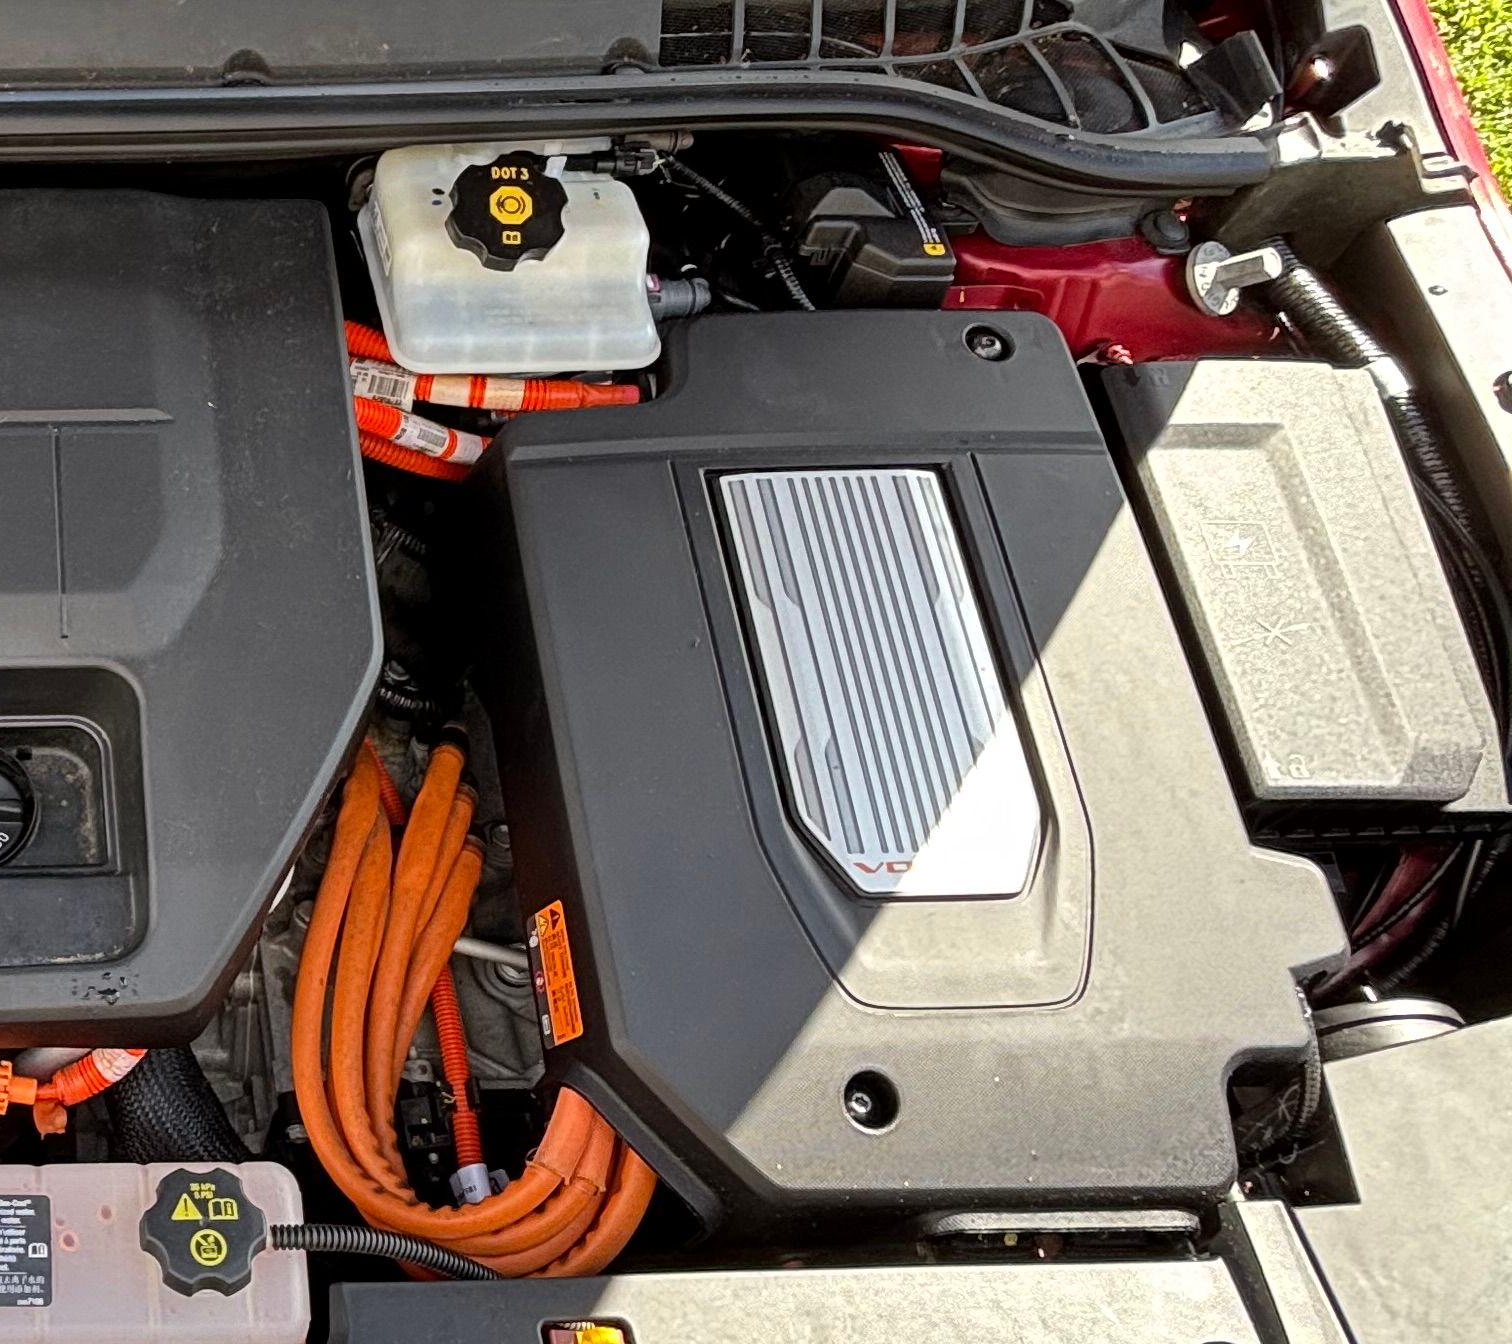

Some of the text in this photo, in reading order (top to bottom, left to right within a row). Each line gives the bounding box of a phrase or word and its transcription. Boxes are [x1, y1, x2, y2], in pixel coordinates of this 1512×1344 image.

[491, 166, 530, 180] DOT 3
[853, 861, 913, 873] VO
